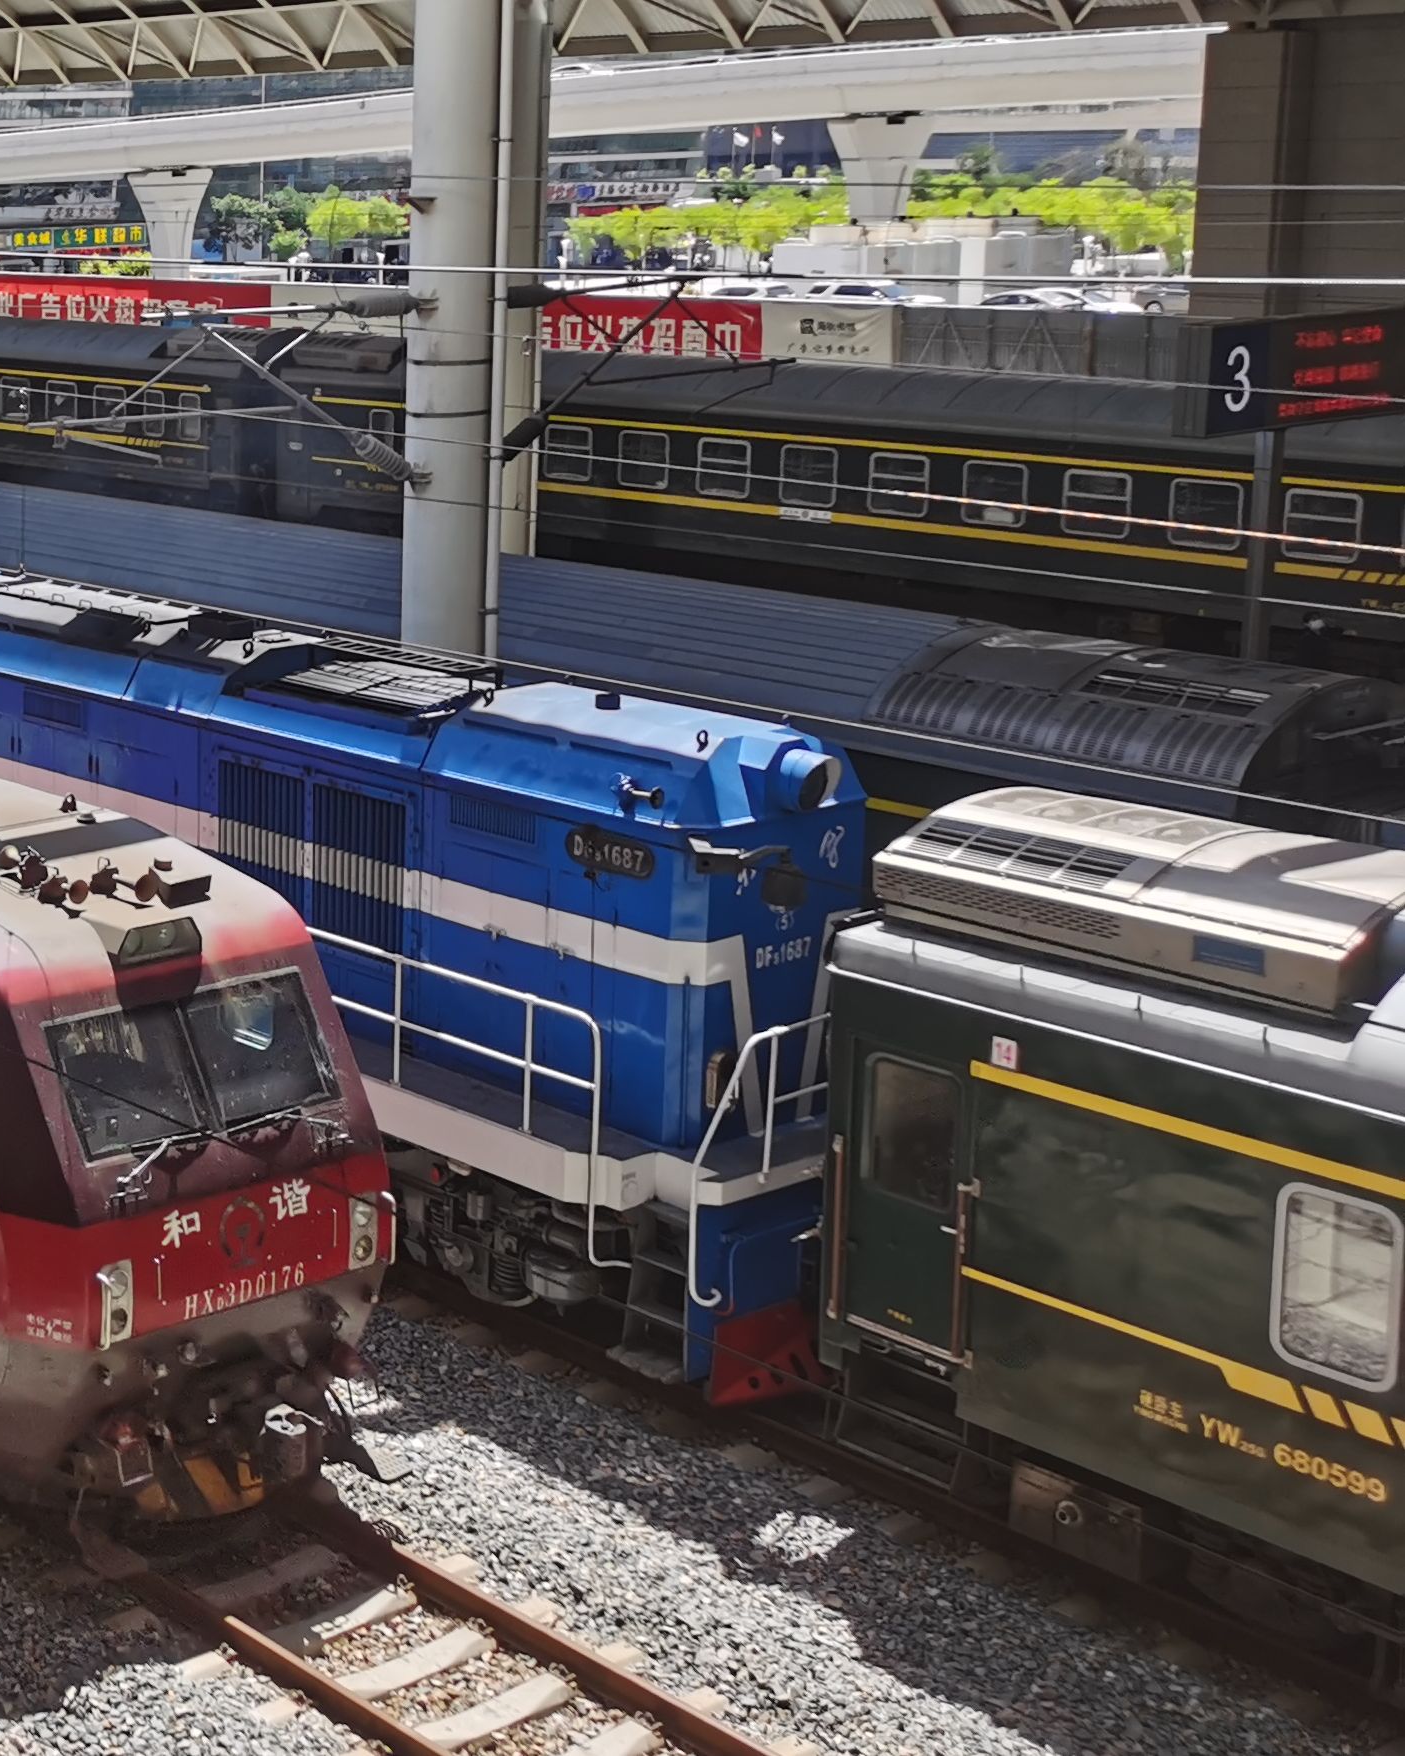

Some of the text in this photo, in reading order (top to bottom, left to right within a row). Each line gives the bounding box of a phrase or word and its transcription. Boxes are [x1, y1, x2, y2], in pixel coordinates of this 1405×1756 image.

[74, 225, 142, 245] 华联超市
[1224, 345, 1251, 412] 3
[161, 1178, 311, 1249] 和 谐
[1273, 1443, 1386, 1502] 680599
